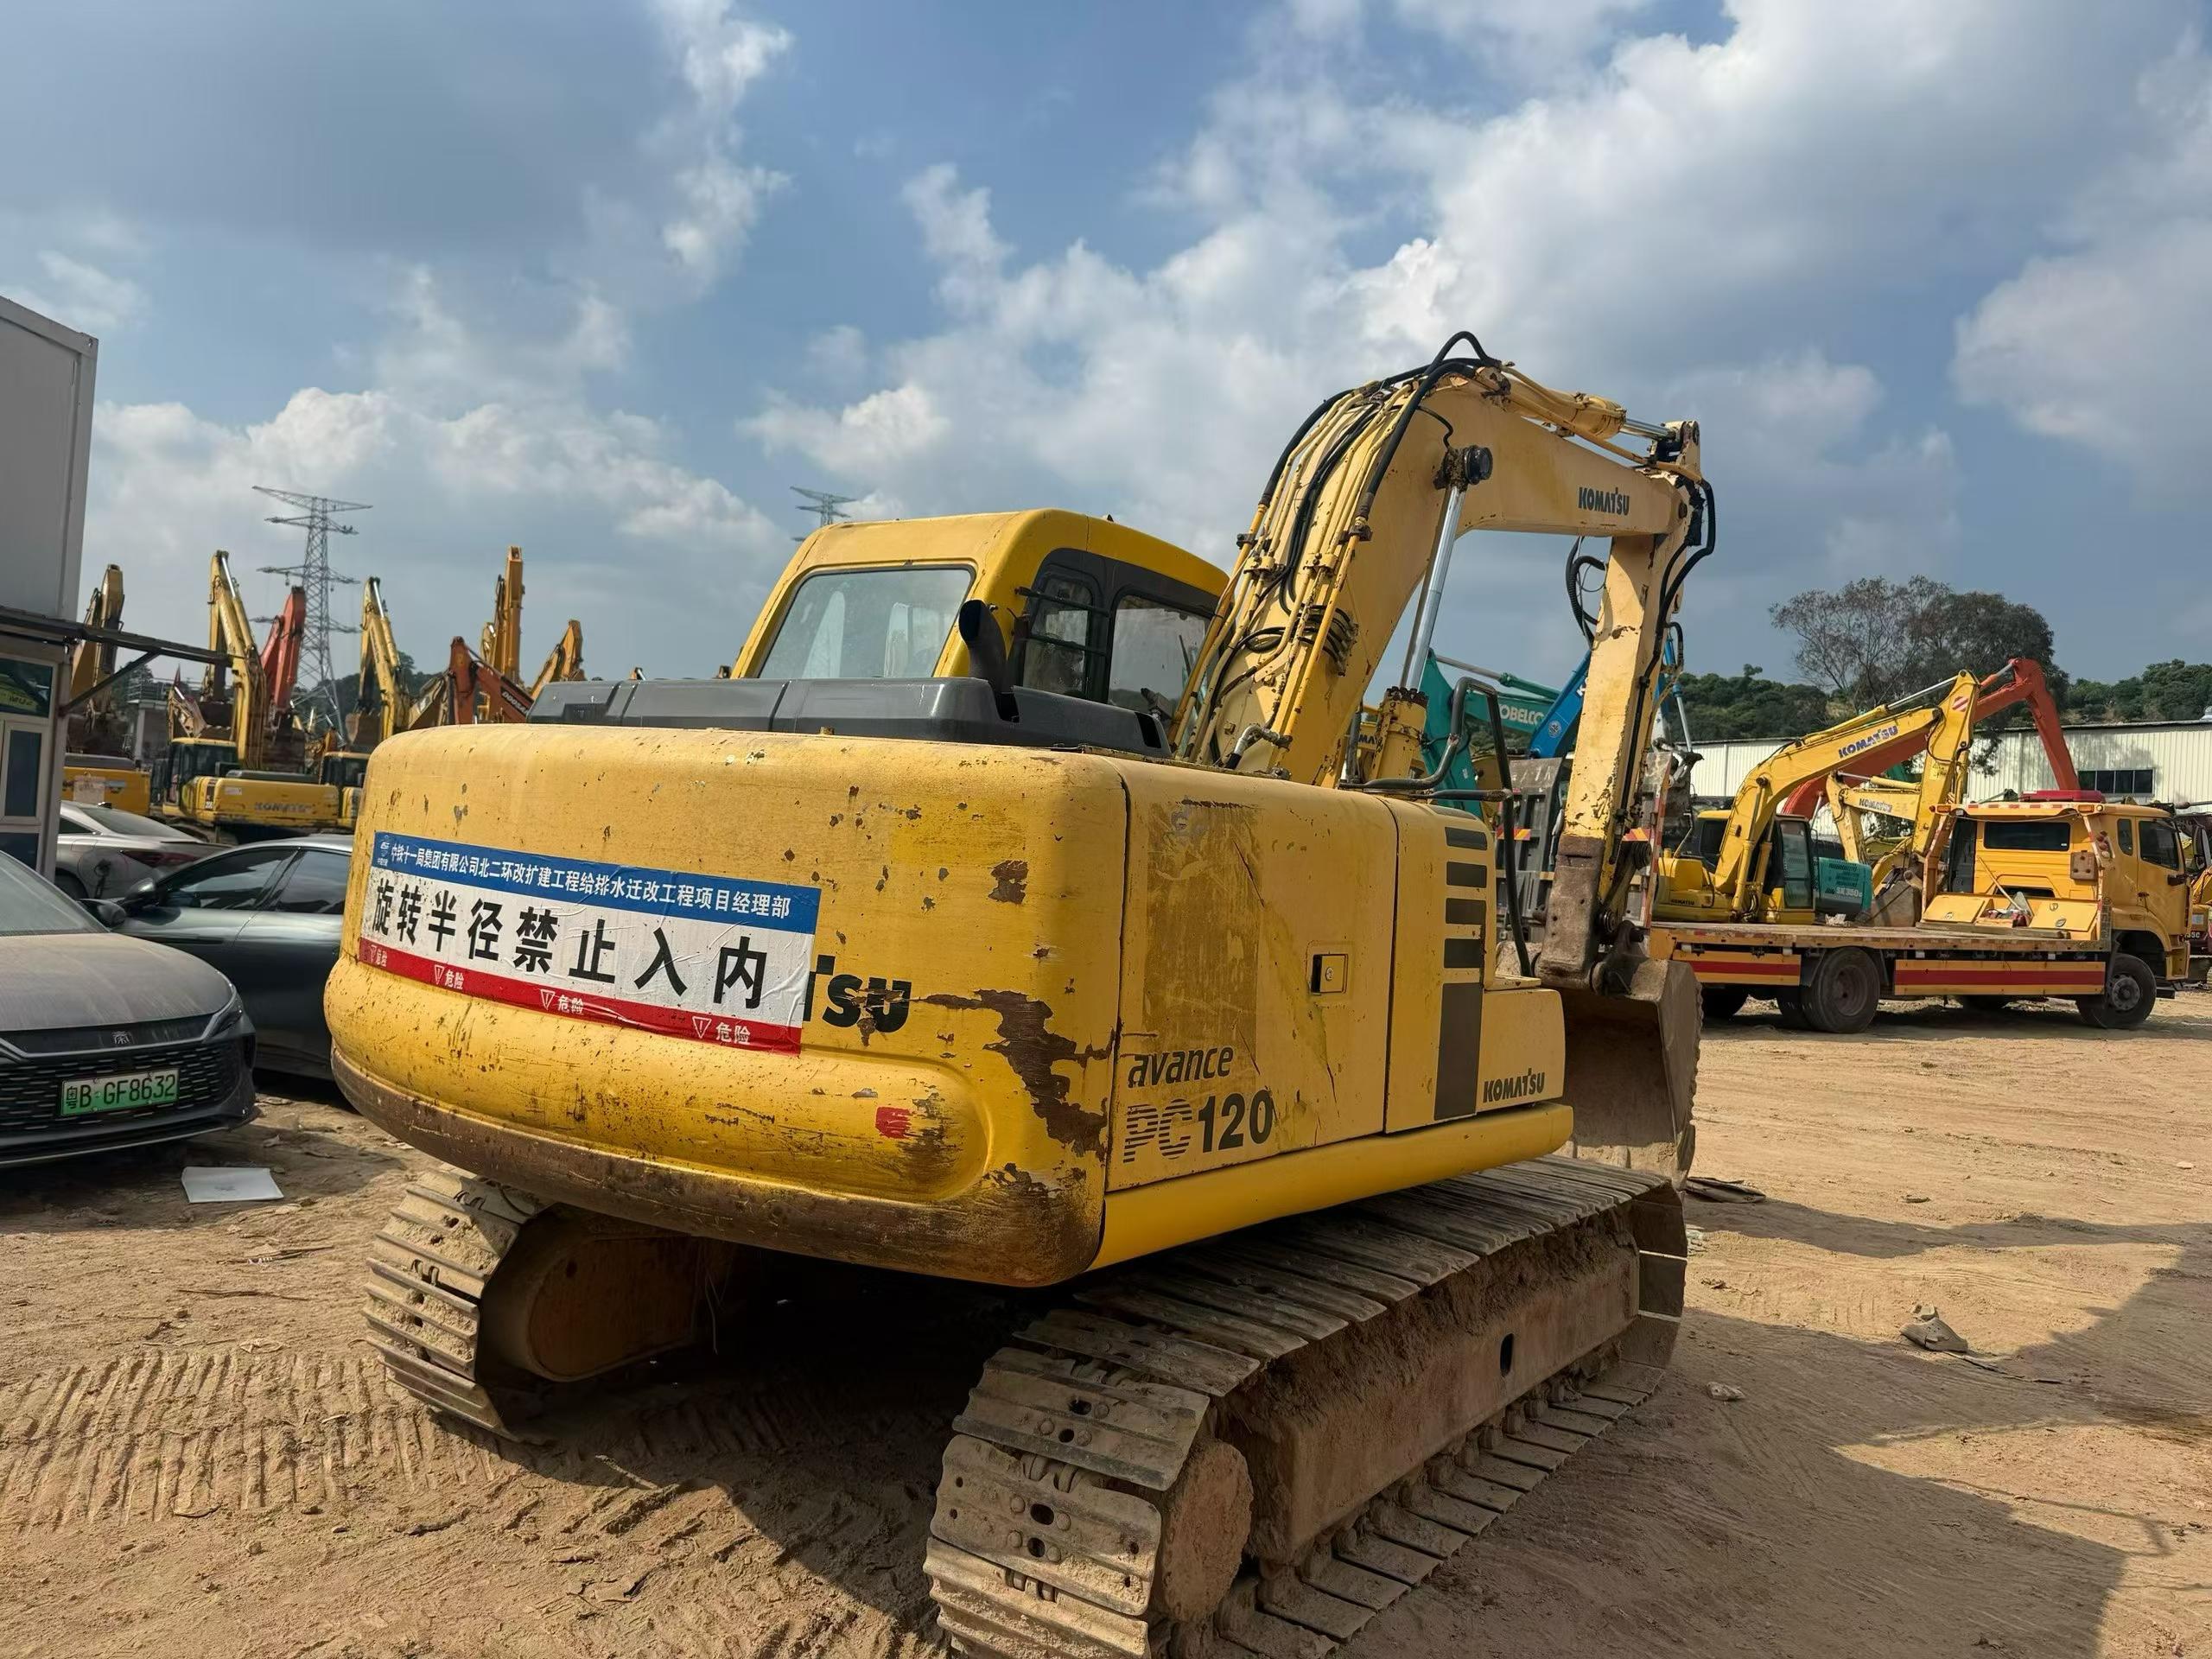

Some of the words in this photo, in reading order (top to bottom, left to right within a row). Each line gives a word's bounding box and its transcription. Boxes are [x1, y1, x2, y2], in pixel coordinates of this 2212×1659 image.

[1578, 486, 1630, 516] KOMATSU
[1498, 703, 1545, 726] OBELCO
[1838, 725, 1898, 759] KOMATSU
[372, 878, 768, 1010] 旋转半径禁止入内
[444, 969, 465, 991] 危险
[557, 995, 584, 1015] 危险
[715, 1021, 751, 1045] 危险
[1128, 1046, 1234, 1089] avance
[1483, 1067, 1545, 1103] KOMATSU
